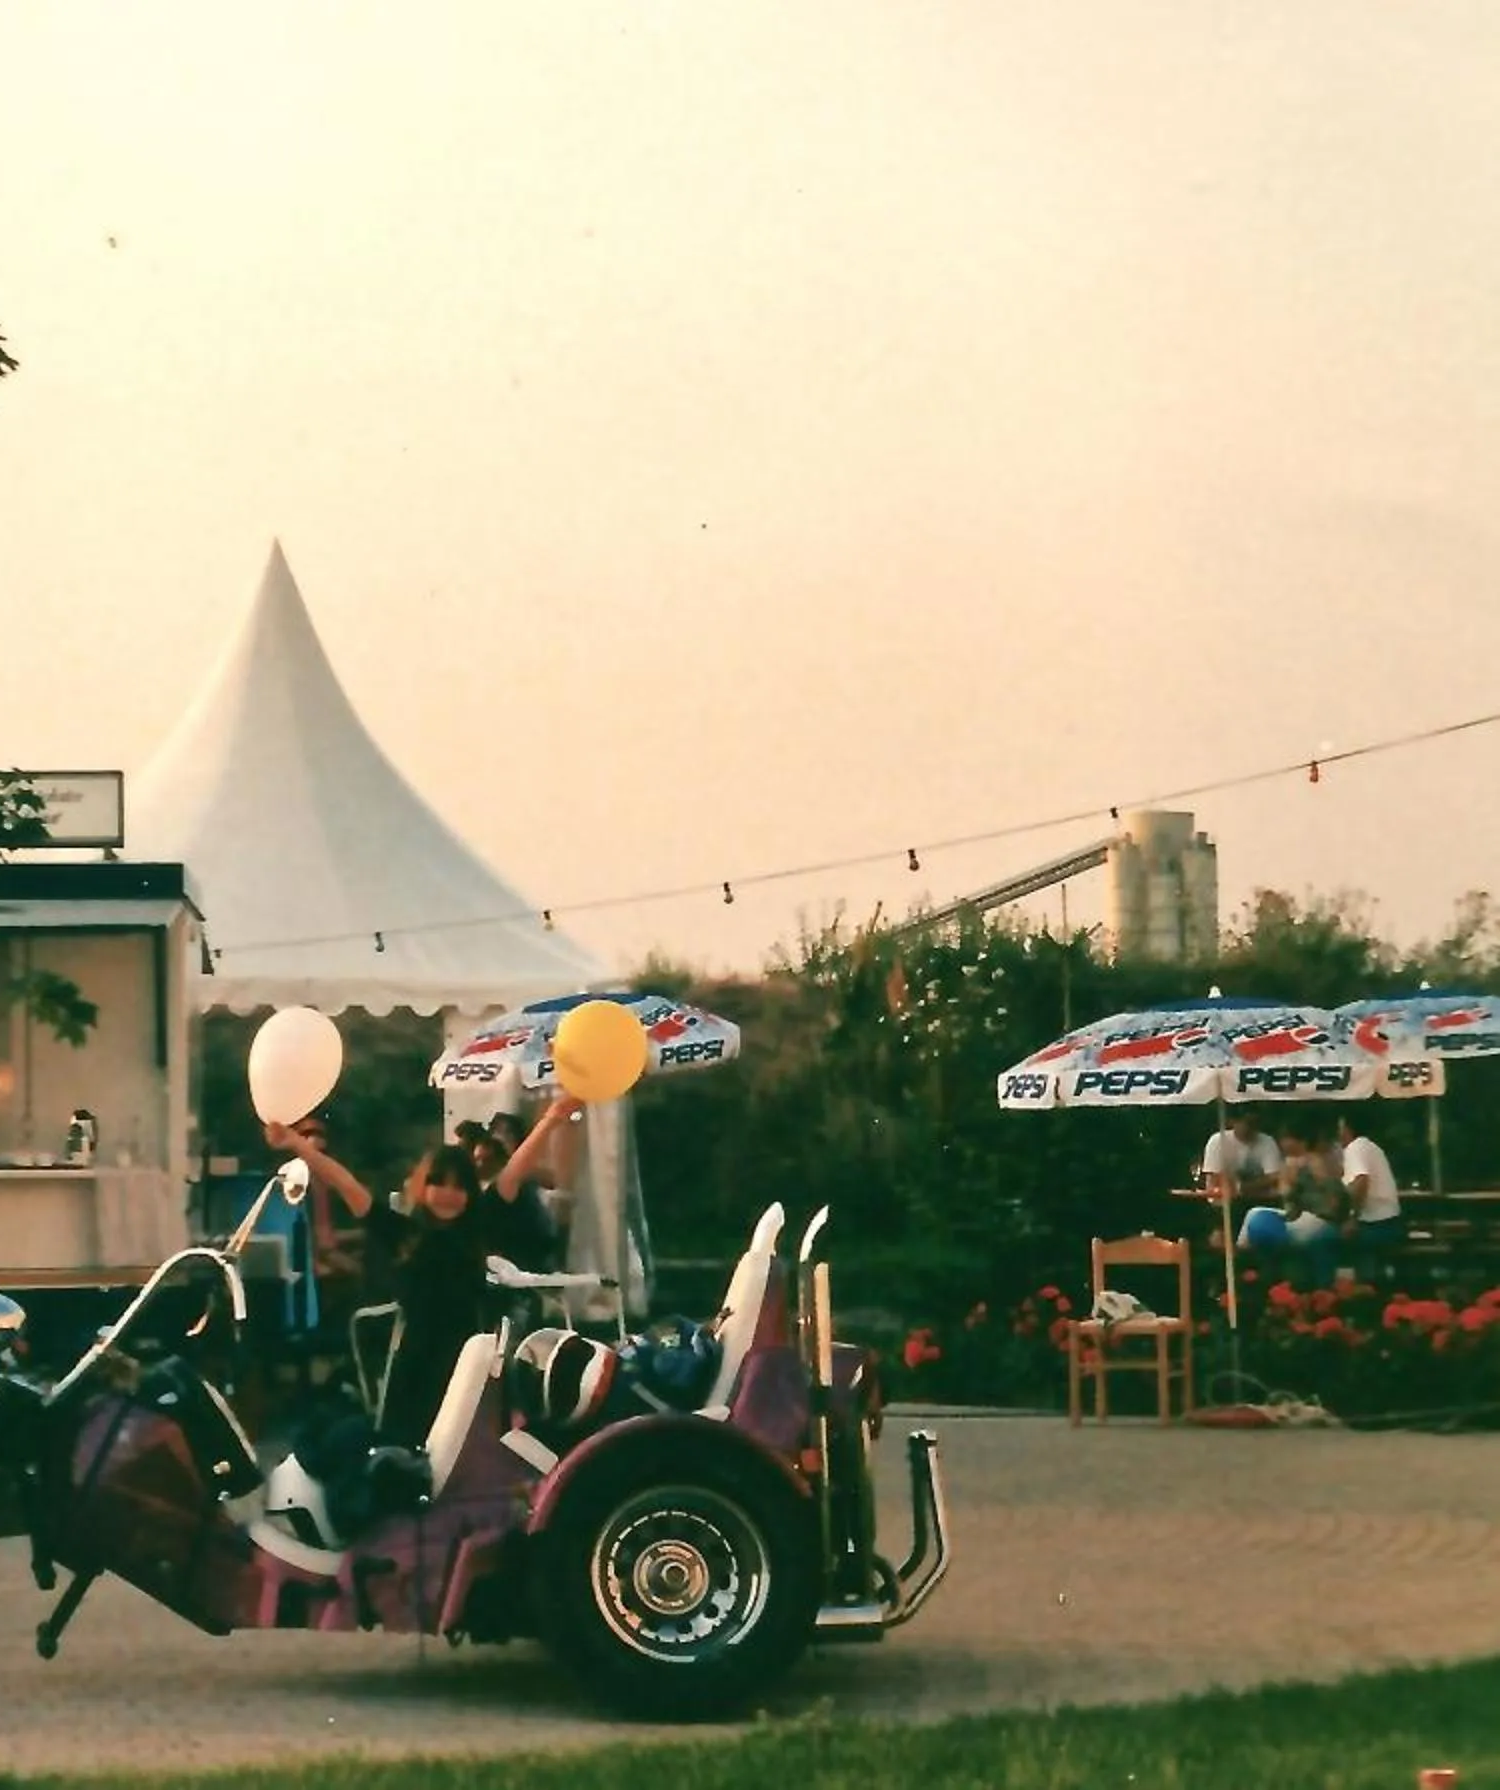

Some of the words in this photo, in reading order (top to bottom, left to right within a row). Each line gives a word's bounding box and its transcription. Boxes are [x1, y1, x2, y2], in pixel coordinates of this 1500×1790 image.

[660, 1039, 725, 1067] PEPSI
[442, 1063, 503, 1082] PEPSI
[1073, 1070, 1190, 1097] PEPSI
[1237, 1066, 1352, 1092] PEPSI
